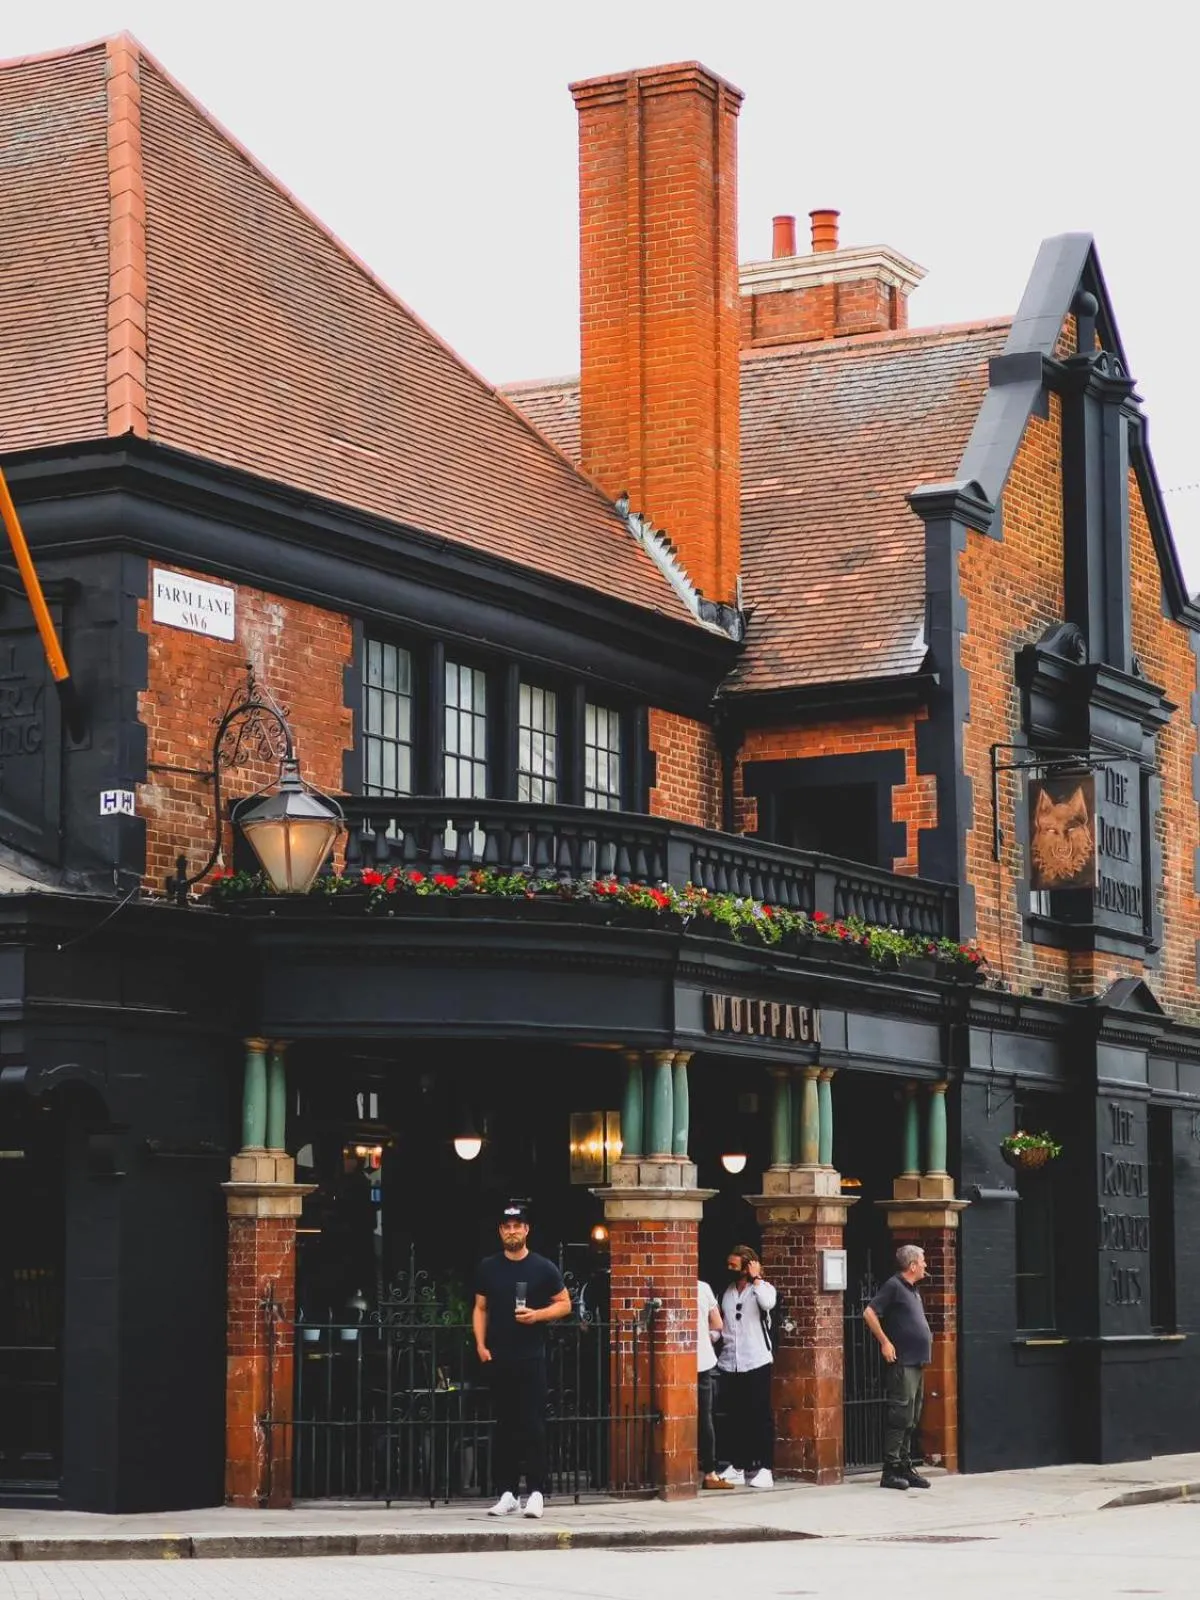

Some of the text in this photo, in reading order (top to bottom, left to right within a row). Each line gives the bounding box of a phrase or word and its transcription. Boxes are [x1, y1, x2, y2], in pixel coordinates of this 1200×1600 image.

[157, 583, 232, 617] FARM LANE
[181, 611, 208, 631] SW6
[103, 792, 117, 809] H
[1104, 766, 1129, 809] THE
[1097, 815, 1132, 864] JOLLY
[711, 993, 822, 1043] WOLFPACK
[1108, 1102, 1136, 1147] THE
[1100, 1151, 1149, 1199] ROYAL
[1104, 1259, 1143, 1307] ALES
